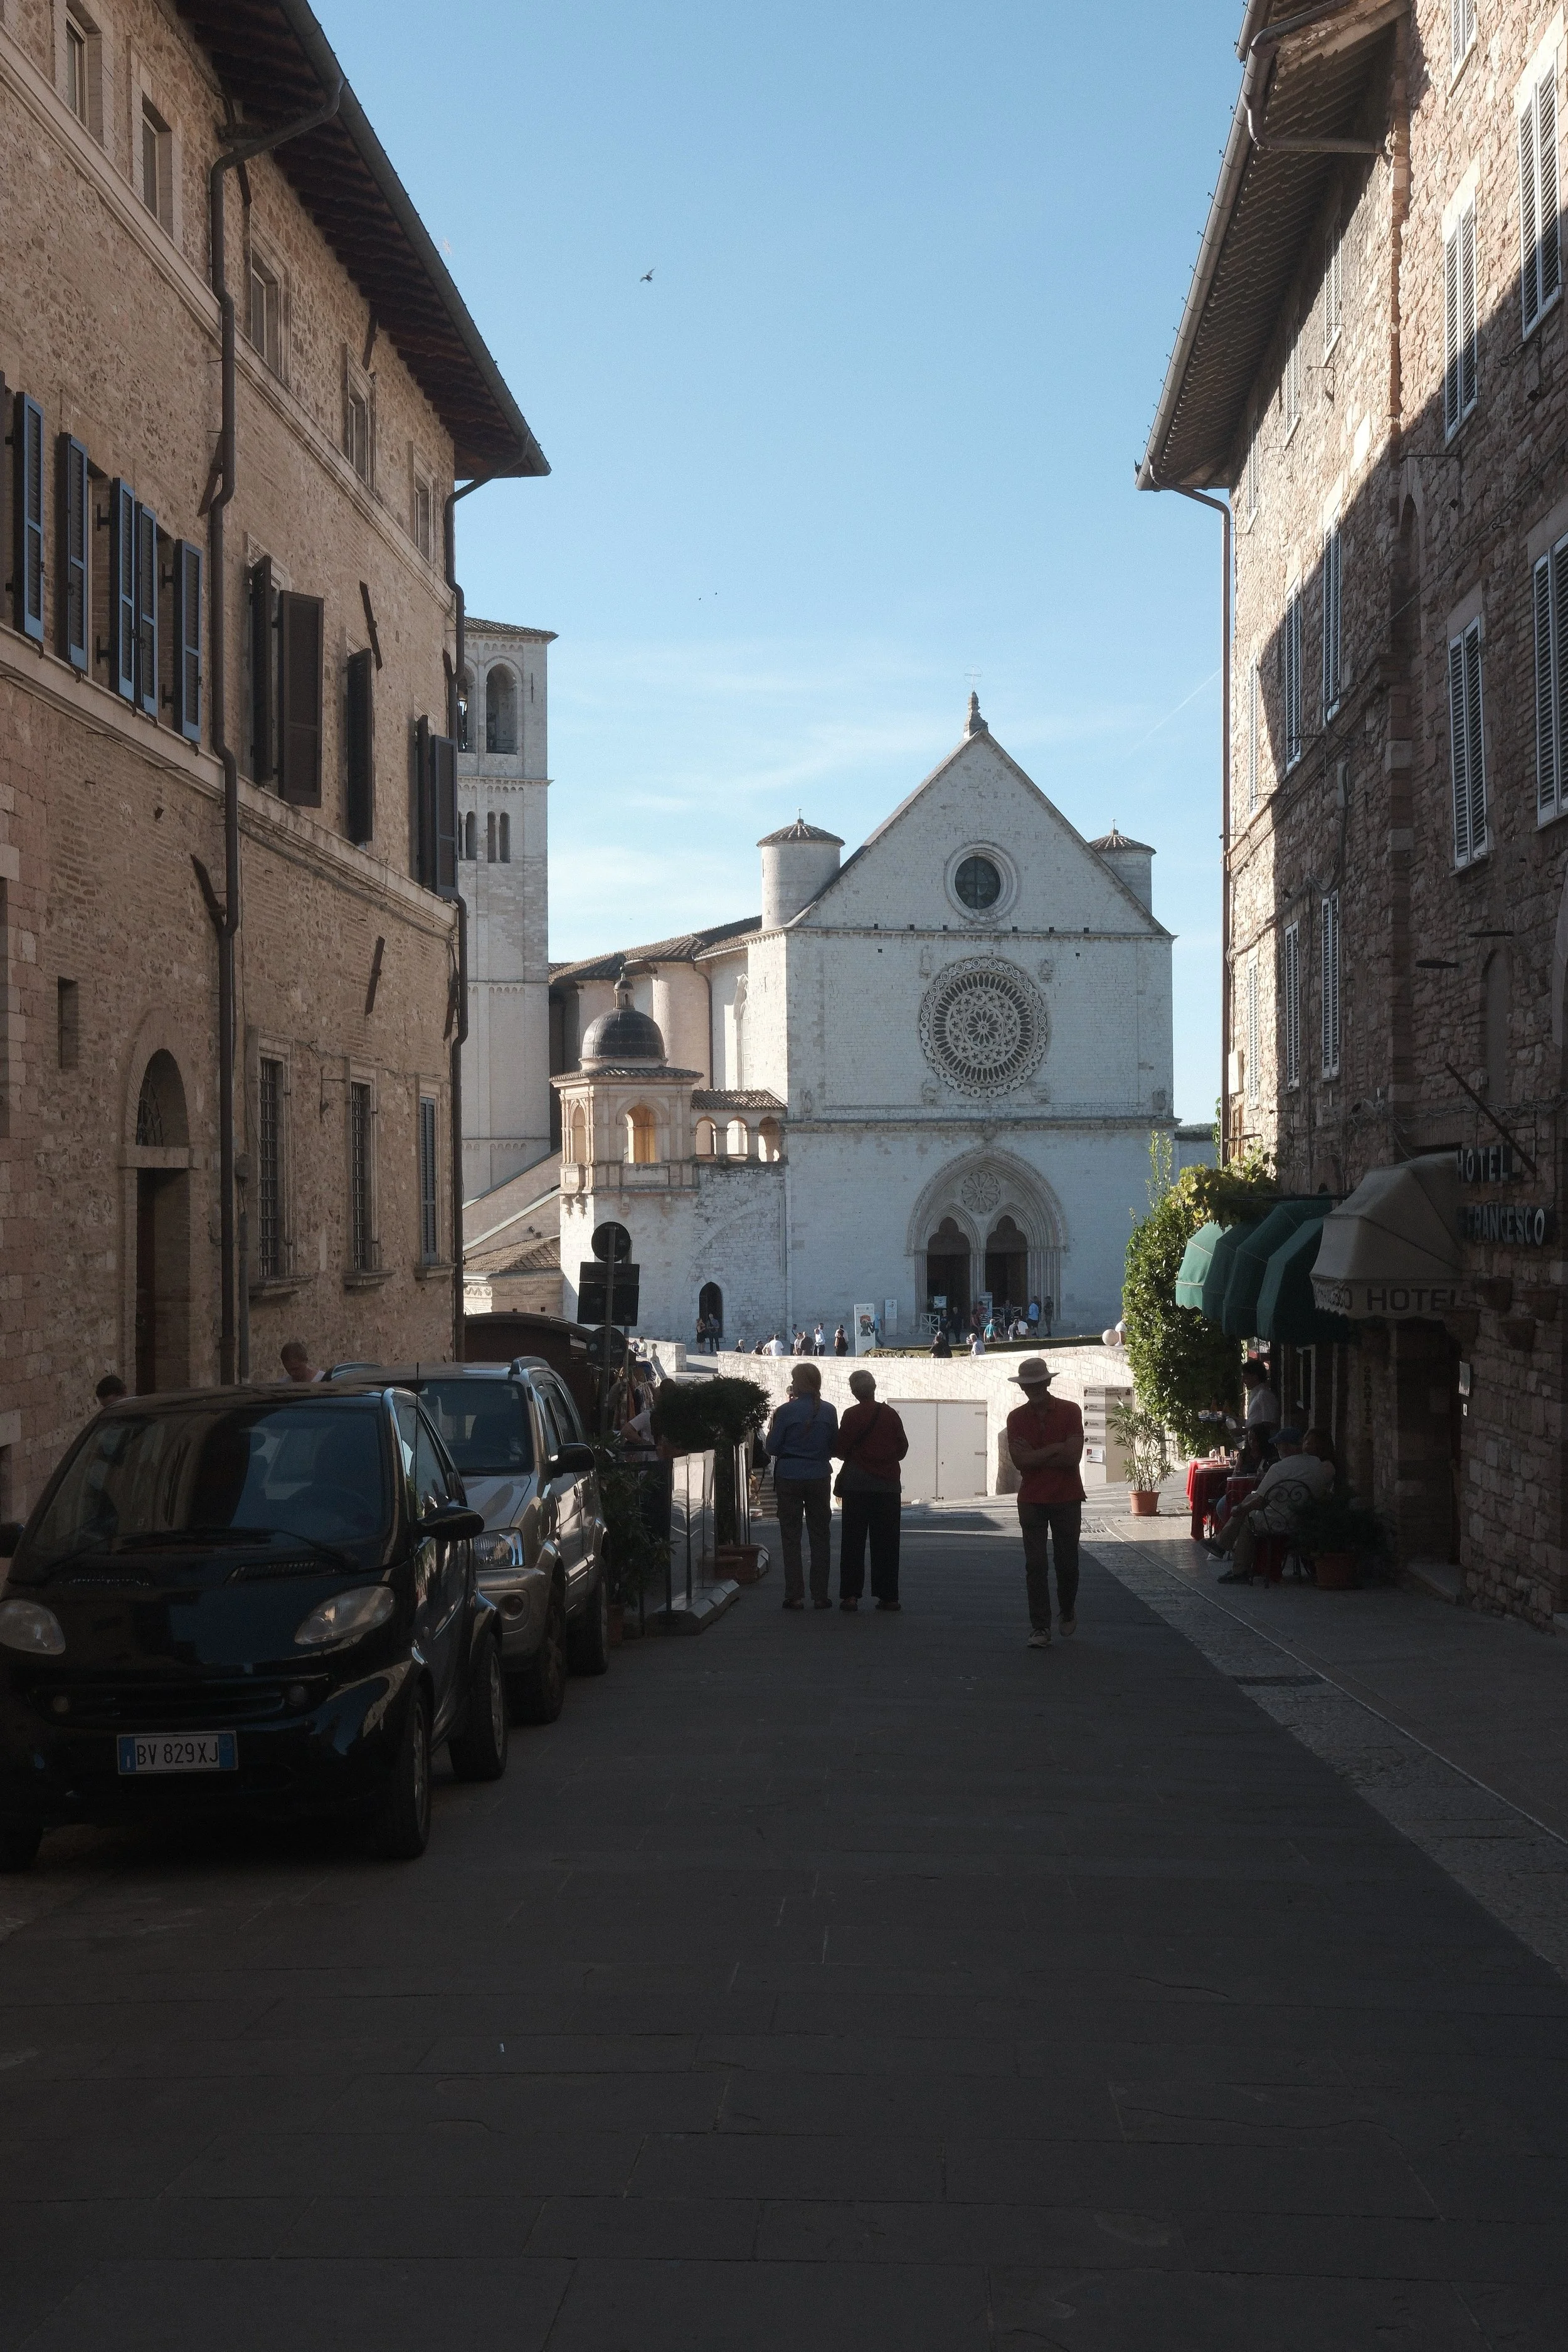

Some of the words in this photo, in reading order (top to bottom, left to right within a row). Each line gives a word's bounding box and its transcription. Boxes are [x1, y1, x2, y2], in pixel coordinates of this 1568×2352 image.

[1457, 1146, 1508, 1182] HOTEL
[137, 1744, 157, 1766] BV
[163, 1742, 218, 1764] 829XJ
